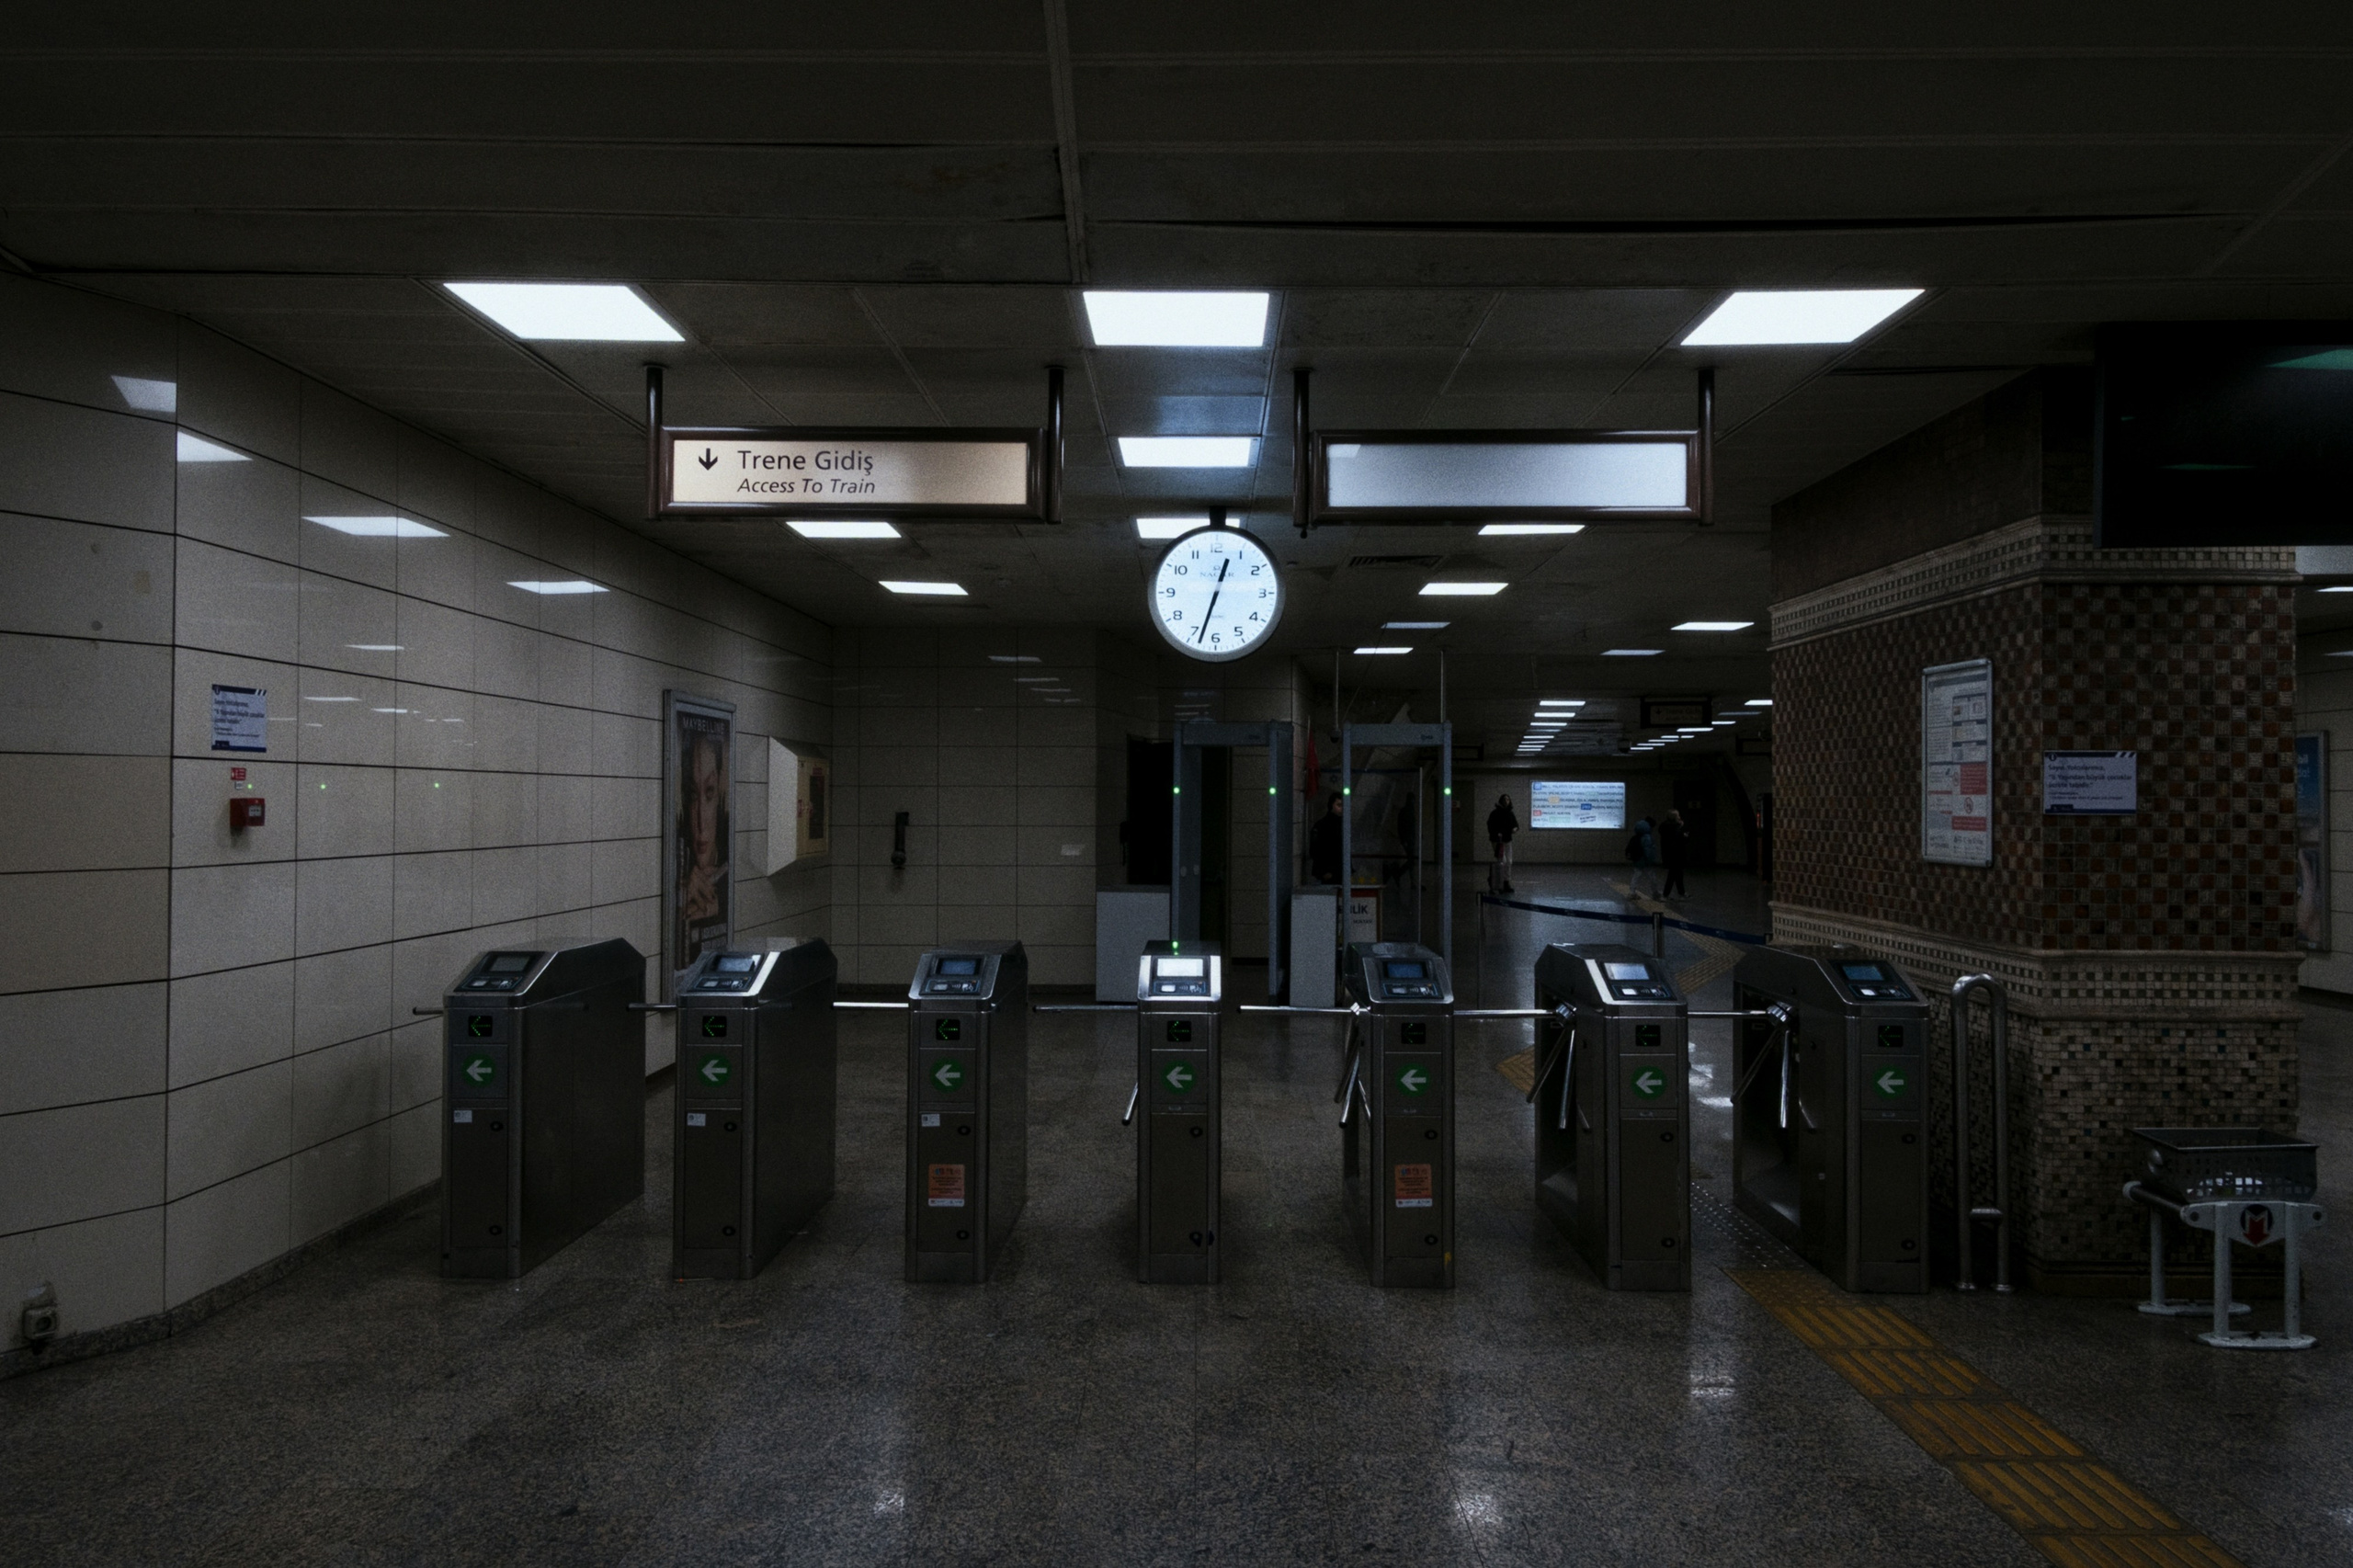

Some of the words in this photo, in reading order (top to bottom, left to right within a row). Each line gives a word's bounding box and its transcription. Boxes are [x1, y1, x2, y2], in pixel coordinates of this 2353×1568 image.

[737, 449, 806, 471] Trene
[814, 449, 874, 476] Gidiş
[737, 478, 795, 494] Access
[802, 478, 823, 494] To
[831, 478, 876, 494] Train
[1211, 542, 1223, 553] 12
[1191, 550, 1199, 560] 11
[1174, 564, 1188, 575] 10
[1250, 565, 1260, 575] 2
[1165, 587, 1176, 598] 9
[1257, 588, 1267, 598] 3
[1173, 610, 1183, 620] 8
[1248, 611, 1258, 621] 4
[1190, 626, 1199, 637] 7
[1233, 626, 1244, 637] 5
[1211, 633, 1221, 643] 6
